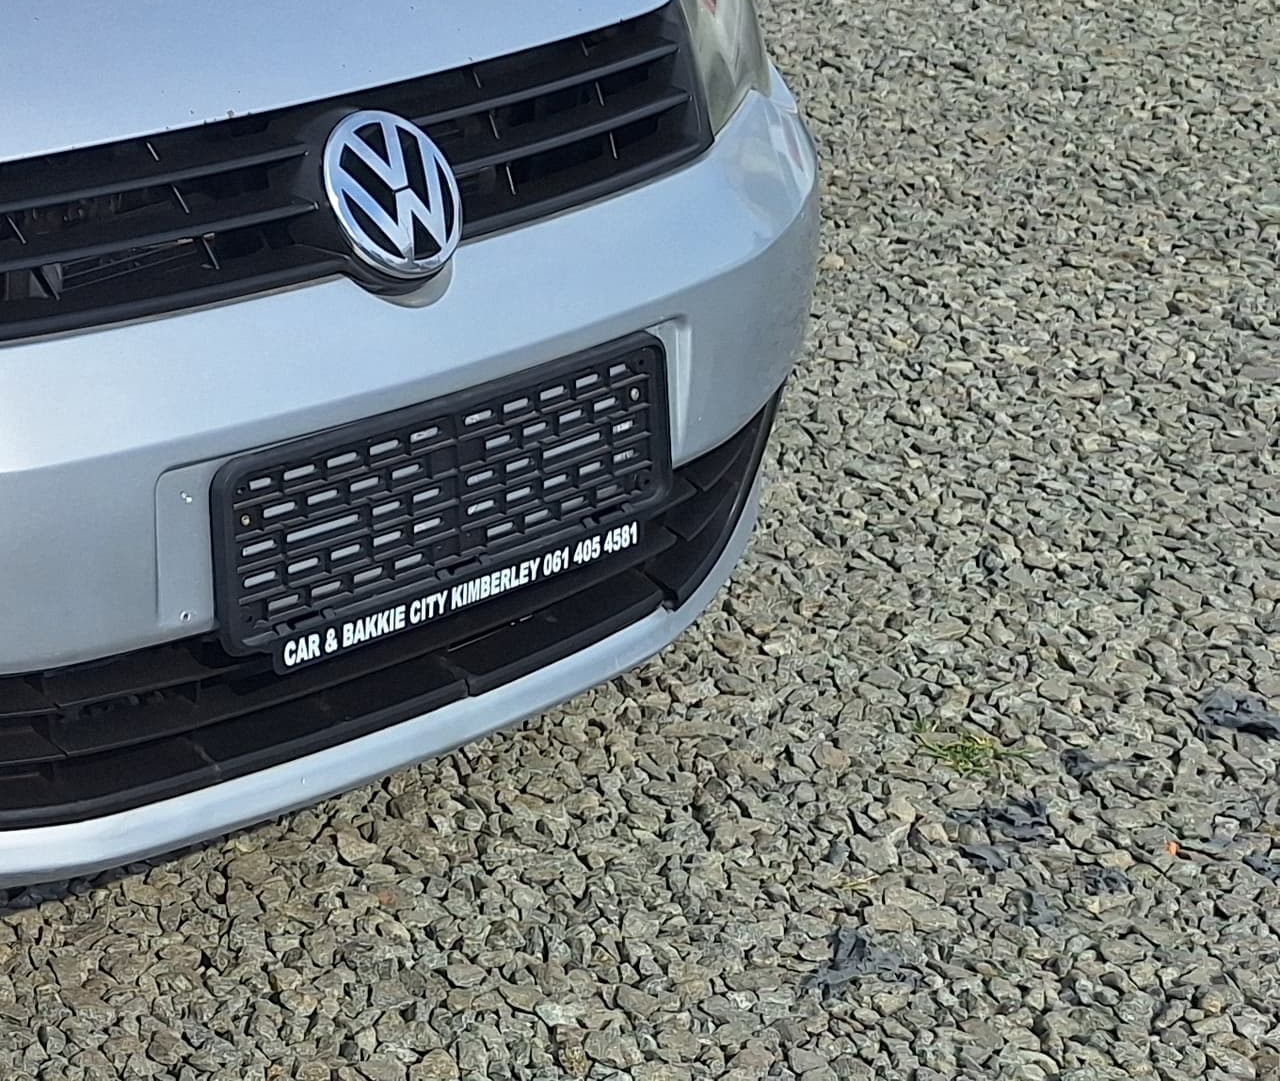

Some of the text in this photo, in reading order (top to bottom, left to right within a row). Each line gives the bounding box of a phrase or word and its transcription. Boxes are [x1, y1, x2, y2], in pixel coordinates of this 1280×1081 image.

[283, 521, 638, 667] CAR & BAKKIE CITY KIMBERLEY 061 405 4581
